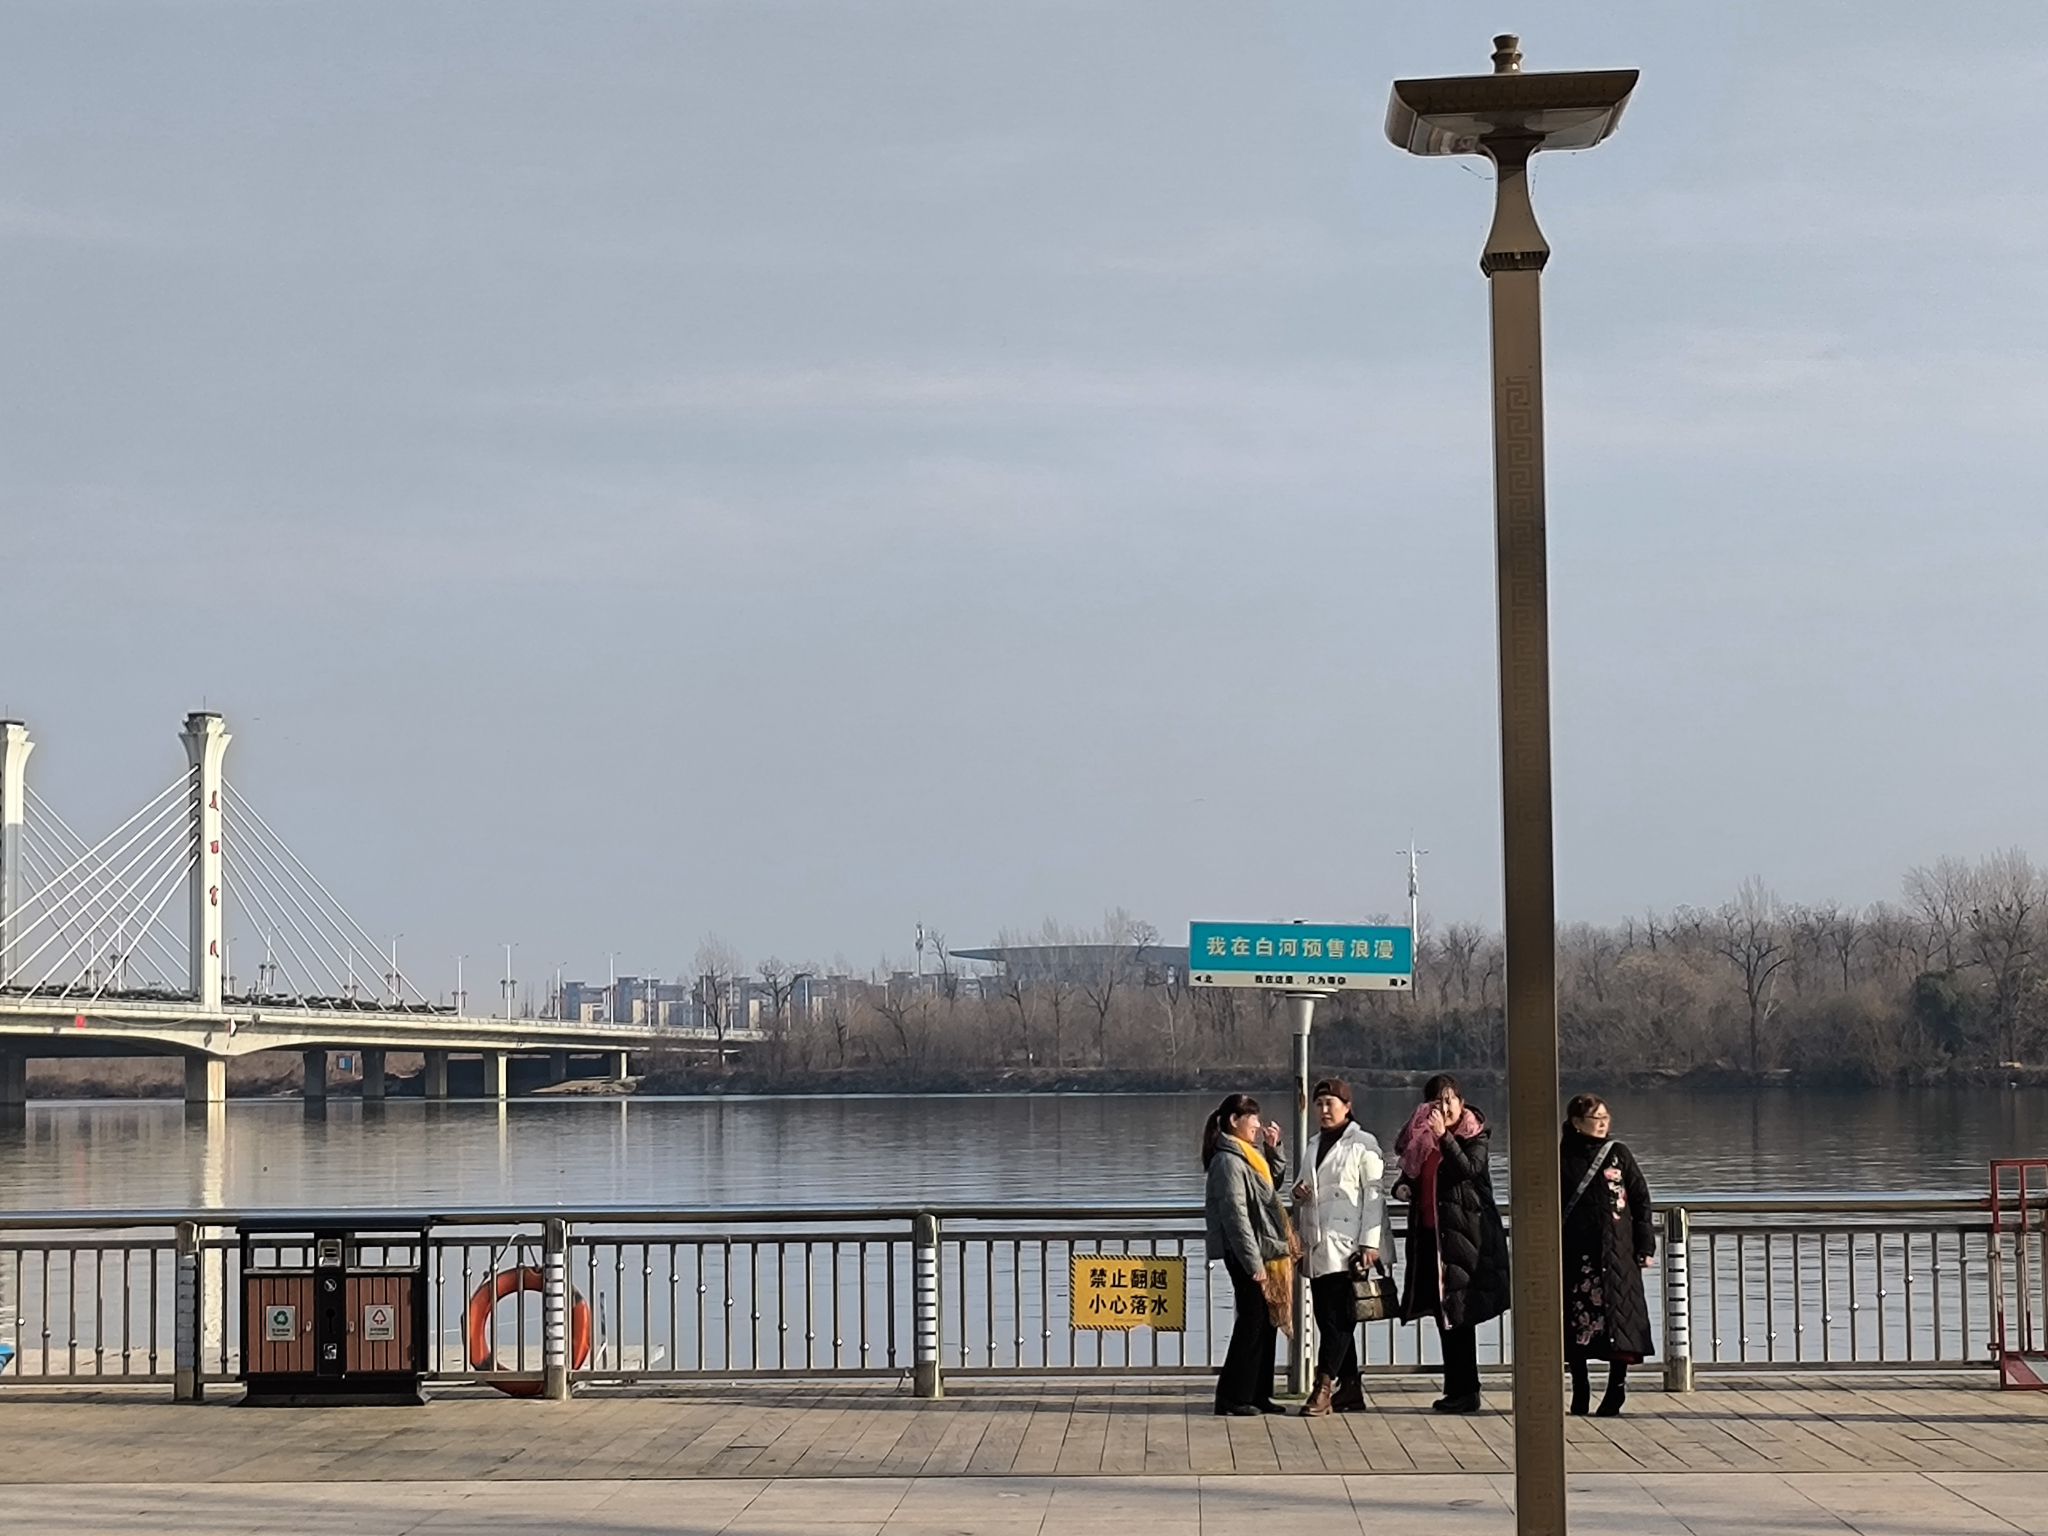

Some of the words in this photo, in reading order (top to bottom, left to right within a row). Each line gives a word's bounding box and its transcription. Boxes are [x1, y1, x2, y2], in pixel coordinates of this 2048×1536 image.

[1206, 936, 1394, 960] 我在白河预售浪漫
[1090, 1268, 1168, 1289] 禁止翻越
[1089, 1294, 1168, 1316] 小心落水
